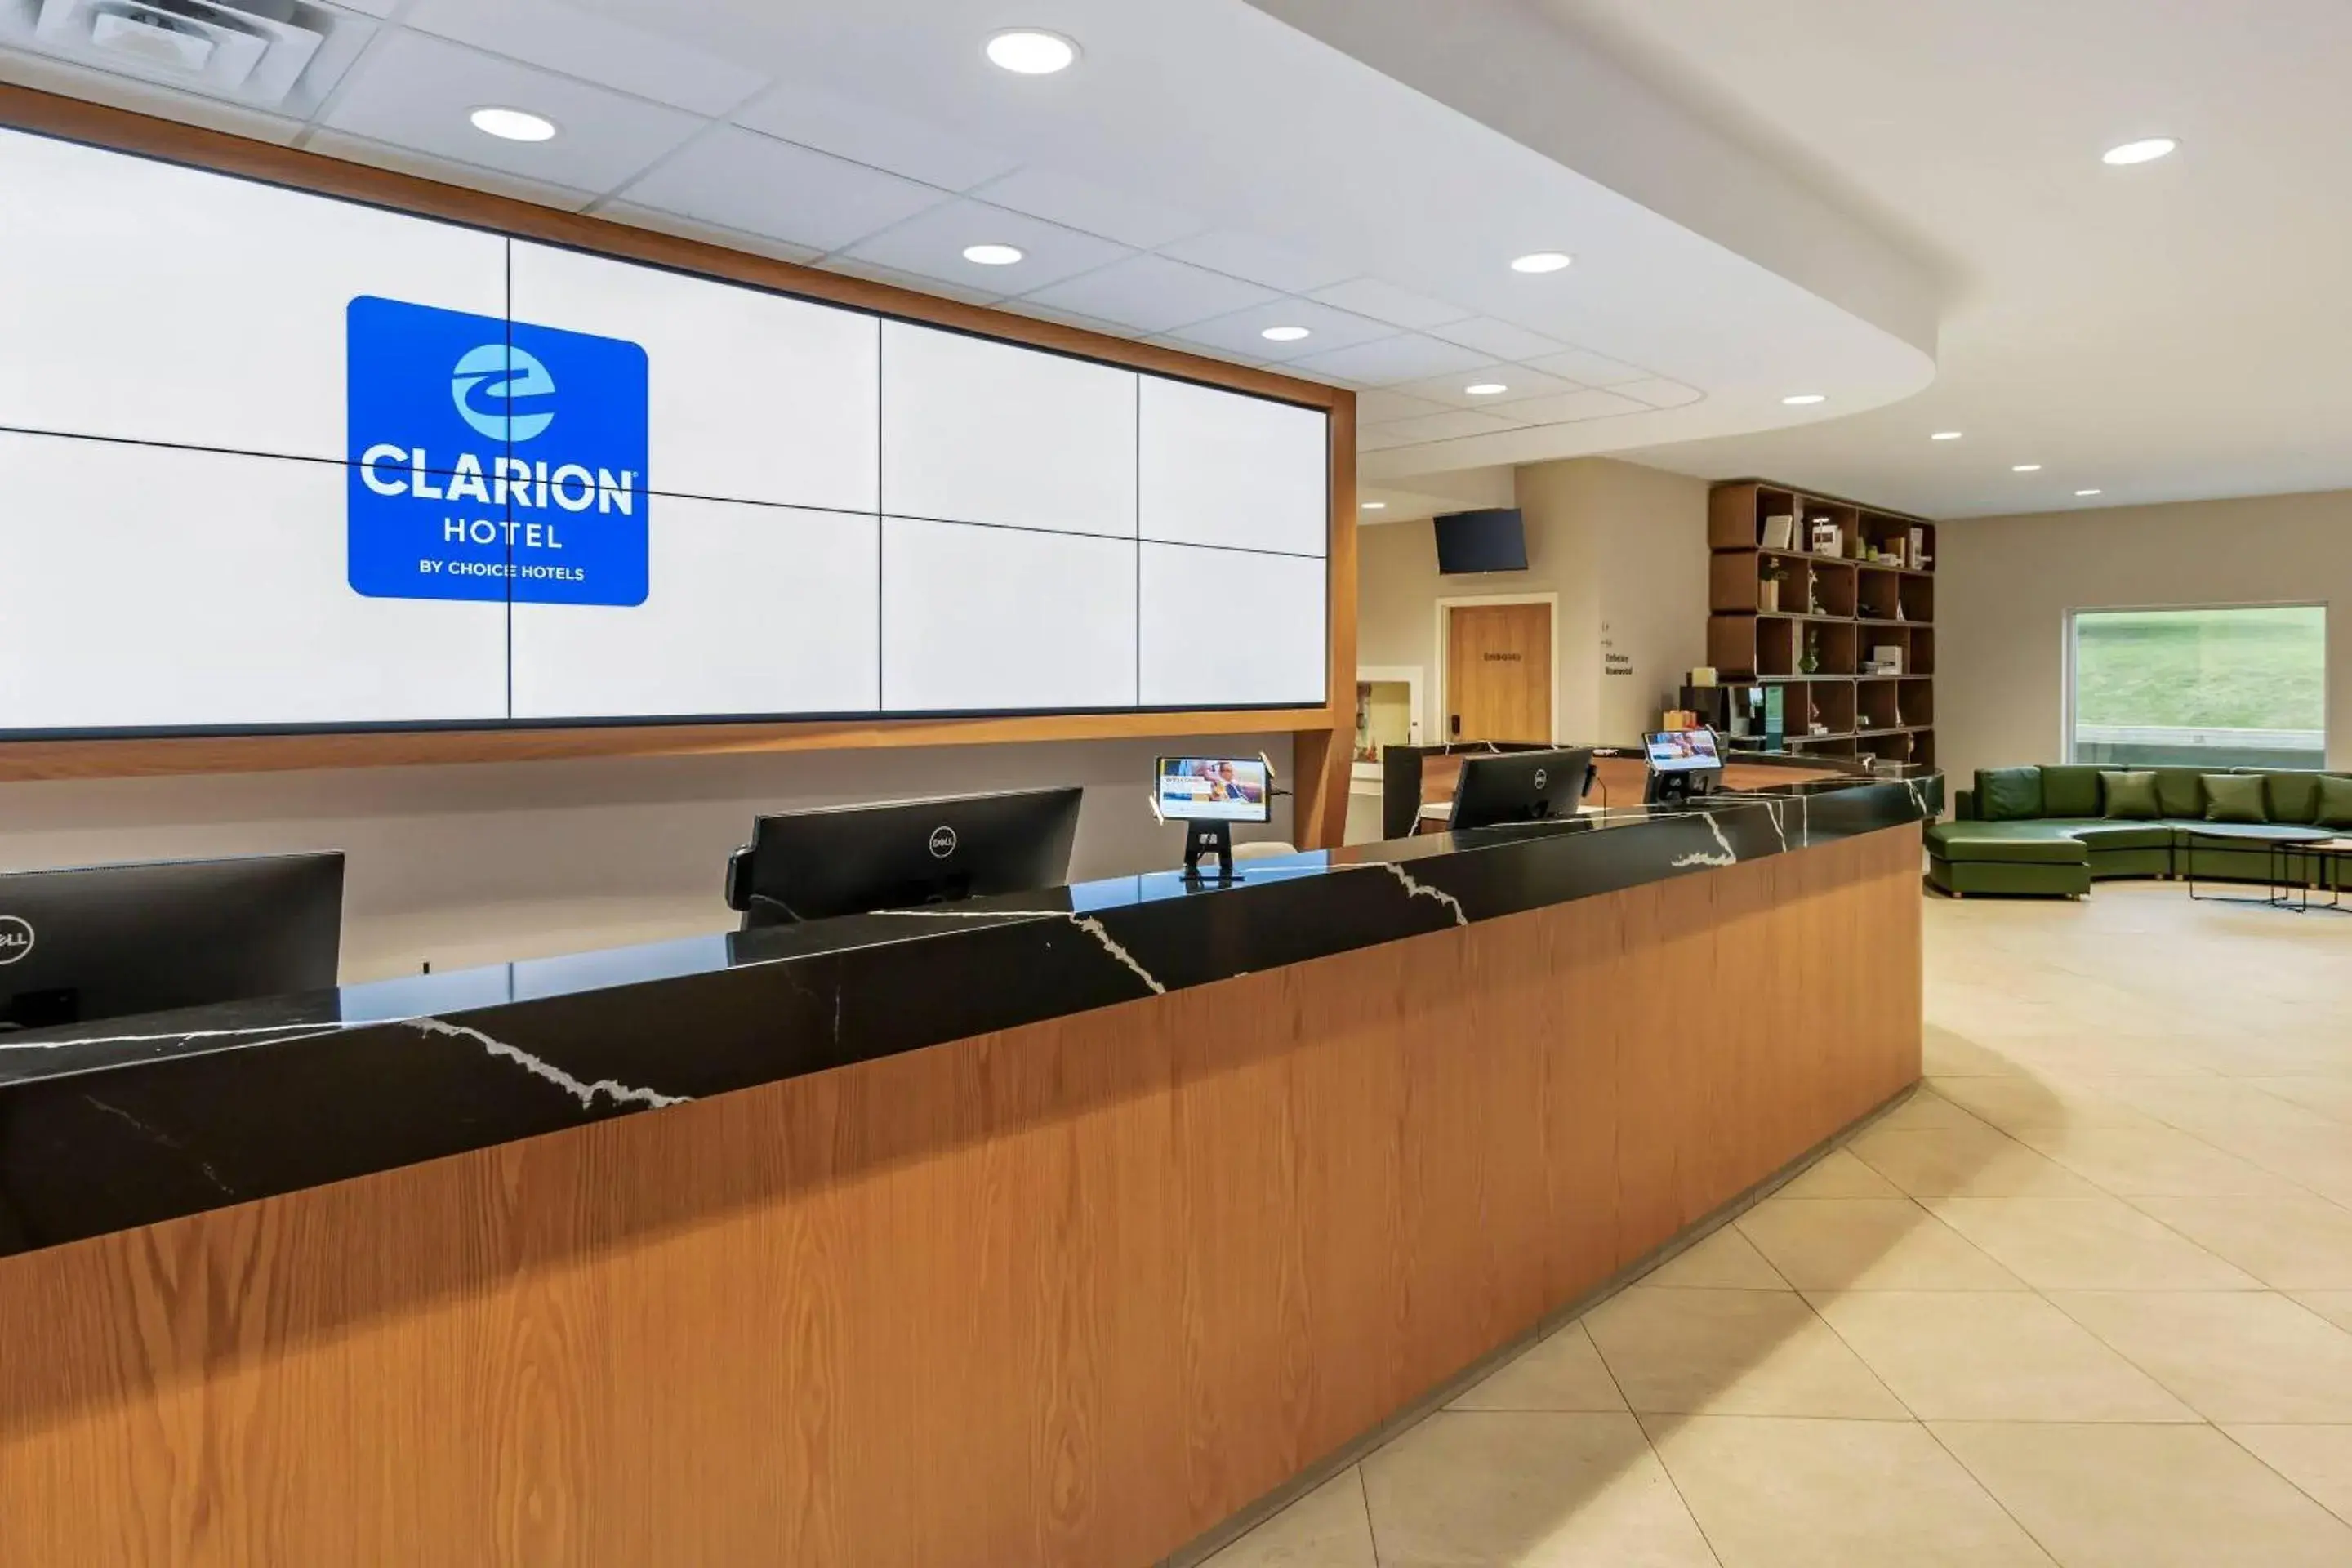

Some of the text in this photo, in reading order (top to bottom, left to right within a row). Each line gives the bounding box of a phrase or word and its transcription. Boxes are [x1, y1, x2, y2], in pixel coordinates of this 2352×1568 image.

[359, 443, 633, 515] CLARION
[443, 517, 563, 549] HOTEL
[419, 559, 586, 581] BY CHOICE HOTELS
[933, 837, 953, 848] DELL
[0, 932, 28, 947] ELL
